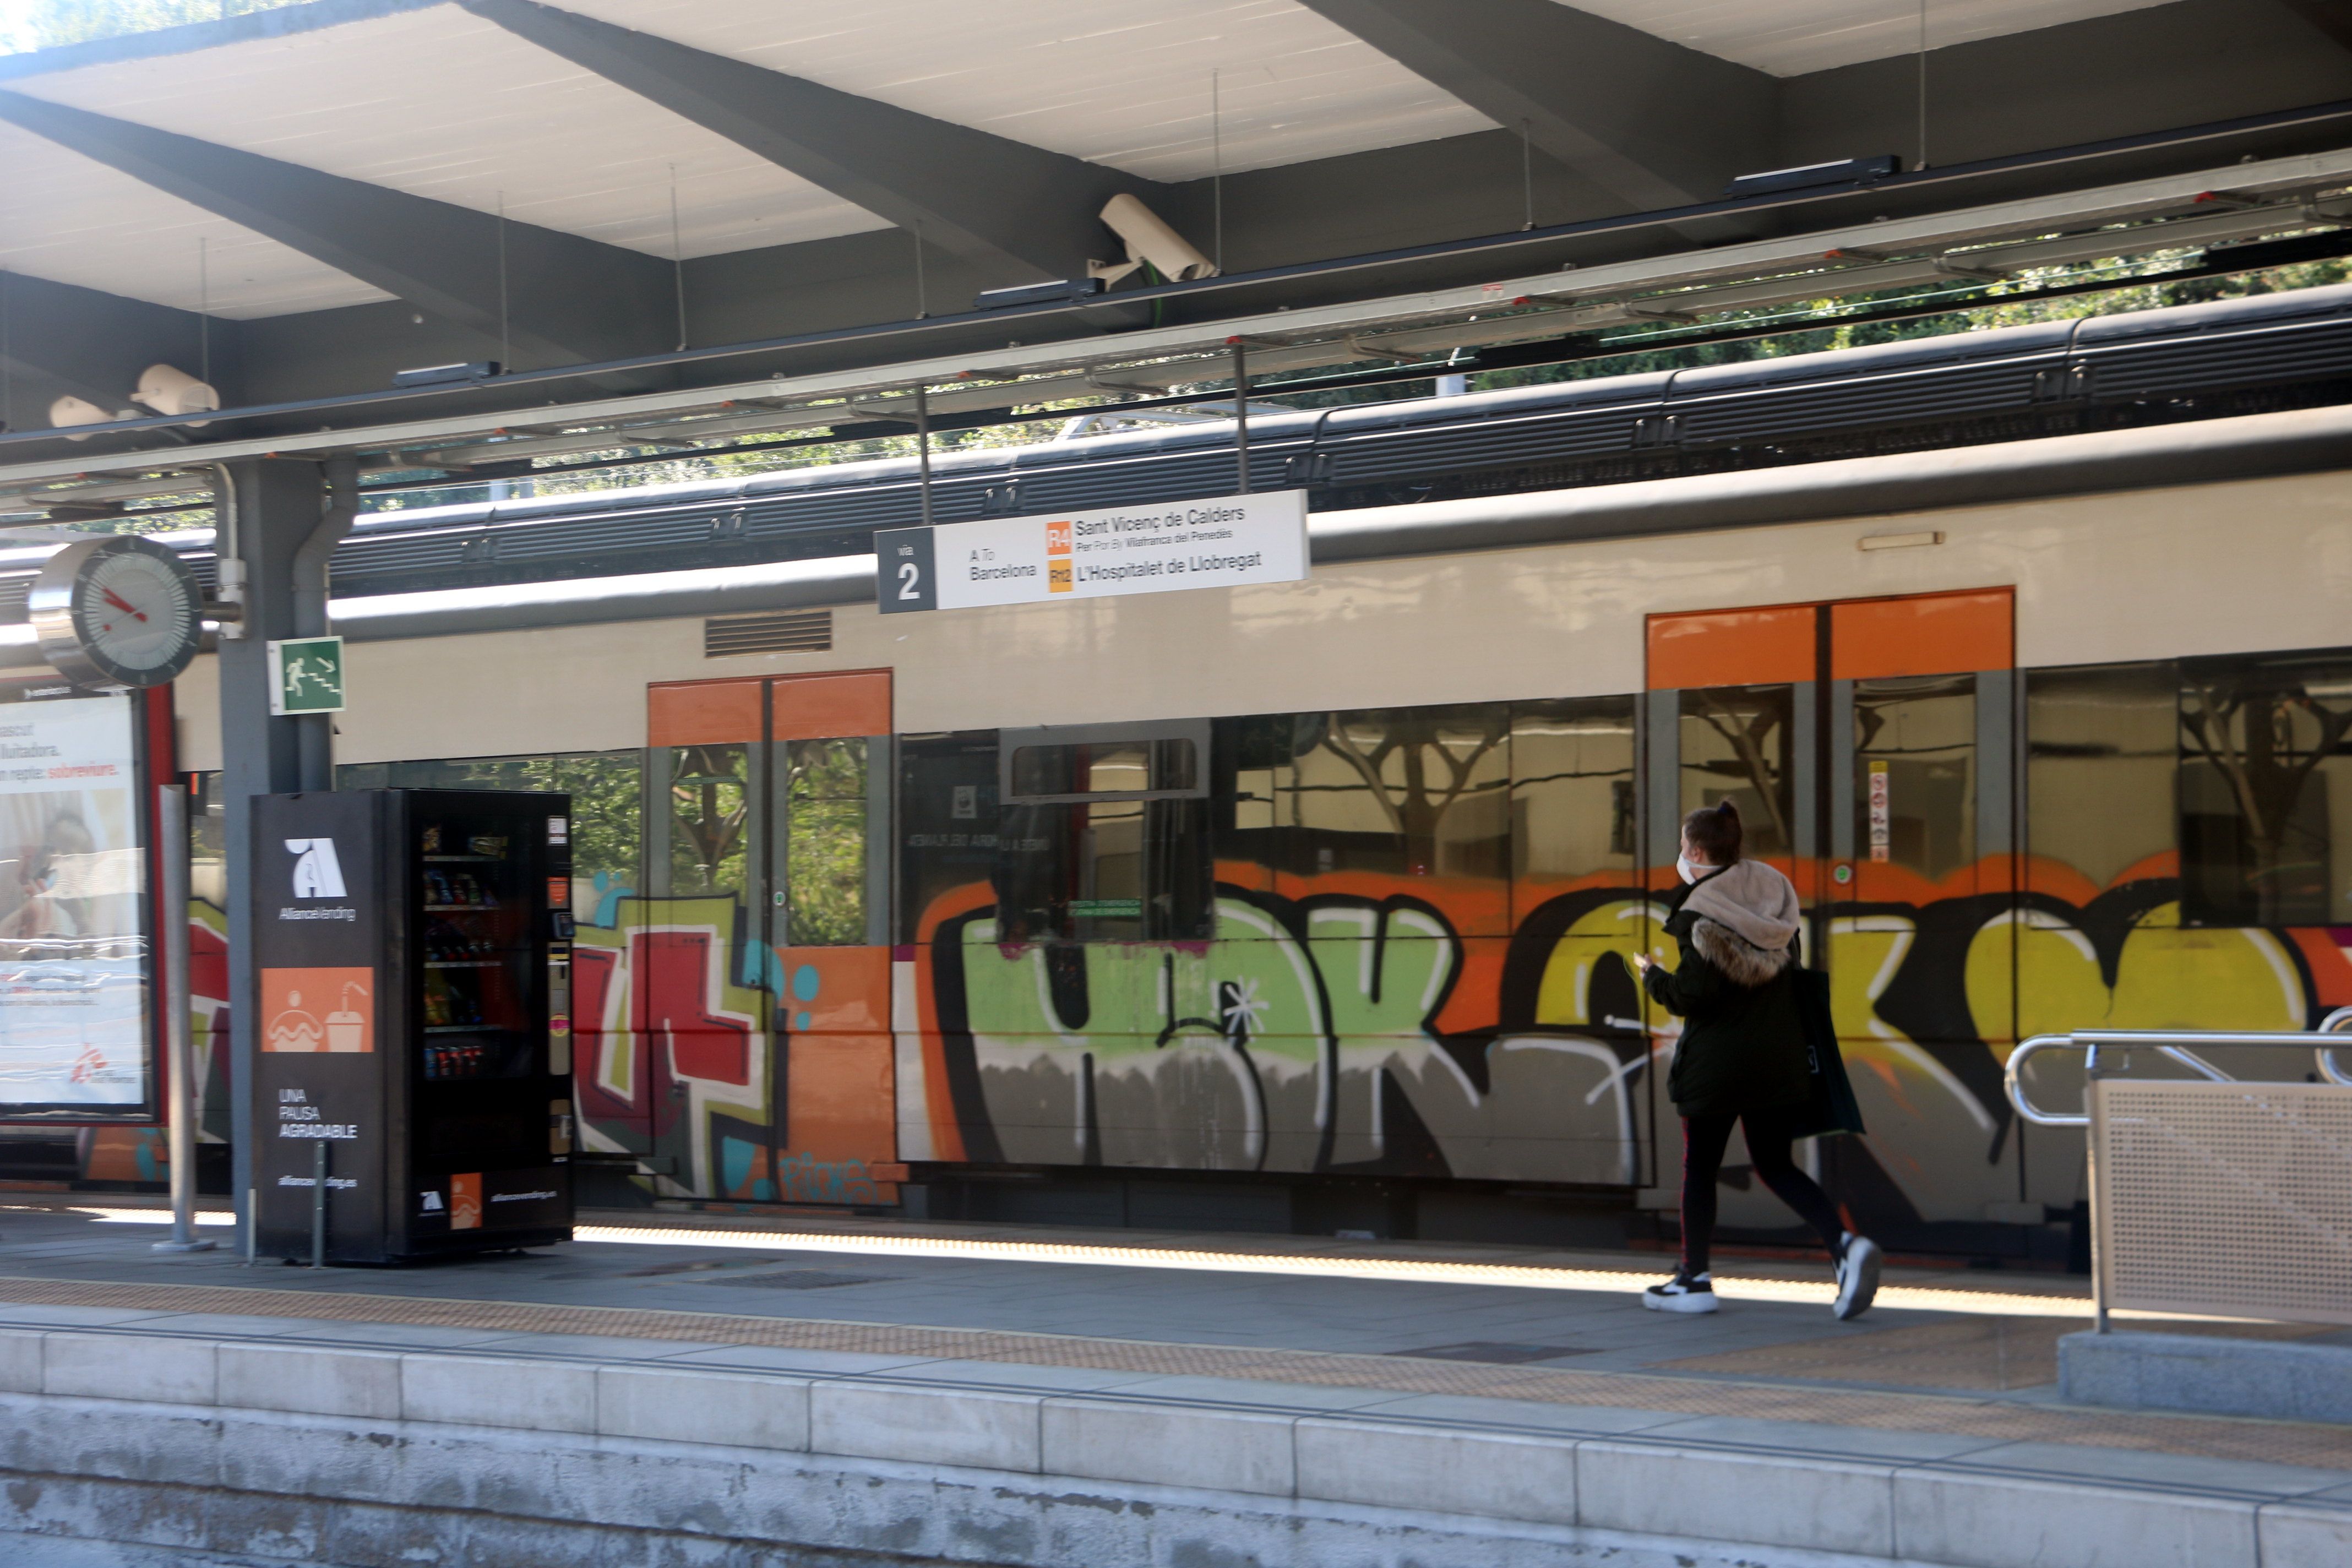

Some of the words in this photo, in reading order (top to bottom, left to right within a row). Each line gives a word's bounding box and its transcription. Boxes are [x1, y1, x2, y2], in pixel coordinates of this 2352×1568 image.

[1075, 519, 1109, 536] Sant
[1110, 516, 1161, 533] Vicenç
[1164, 511, 1183, 527] de
[1187, 507, 1246, 525] Calders
[1048, 529, 1071, 548] R4
[1076, 542, 1092, 552] Per
[1124, 536, 1172, 548] Vilafranca
[1174, 532, 1189, 543] del
[1191, 529, 1234, 541] Penedès
[970, 549, 980, 562] A
[981, 548, 995, 560] To
[971, 563, 1037, 581] Barcelona
[1076, 560, 1164, 582] L'Hospitalet
[1167, 558, 1185, 574] de
[1189, 551, 1261, 571] Llobregat
[897, 563, 921, 600] 2
[1050, 568, 1071, 584] R12
[279, 1088, 307, 1102] UNA
[279, 1106, 321, 1120] PAUSA
[279, 1124, 358, 1139] AGRADABLE
